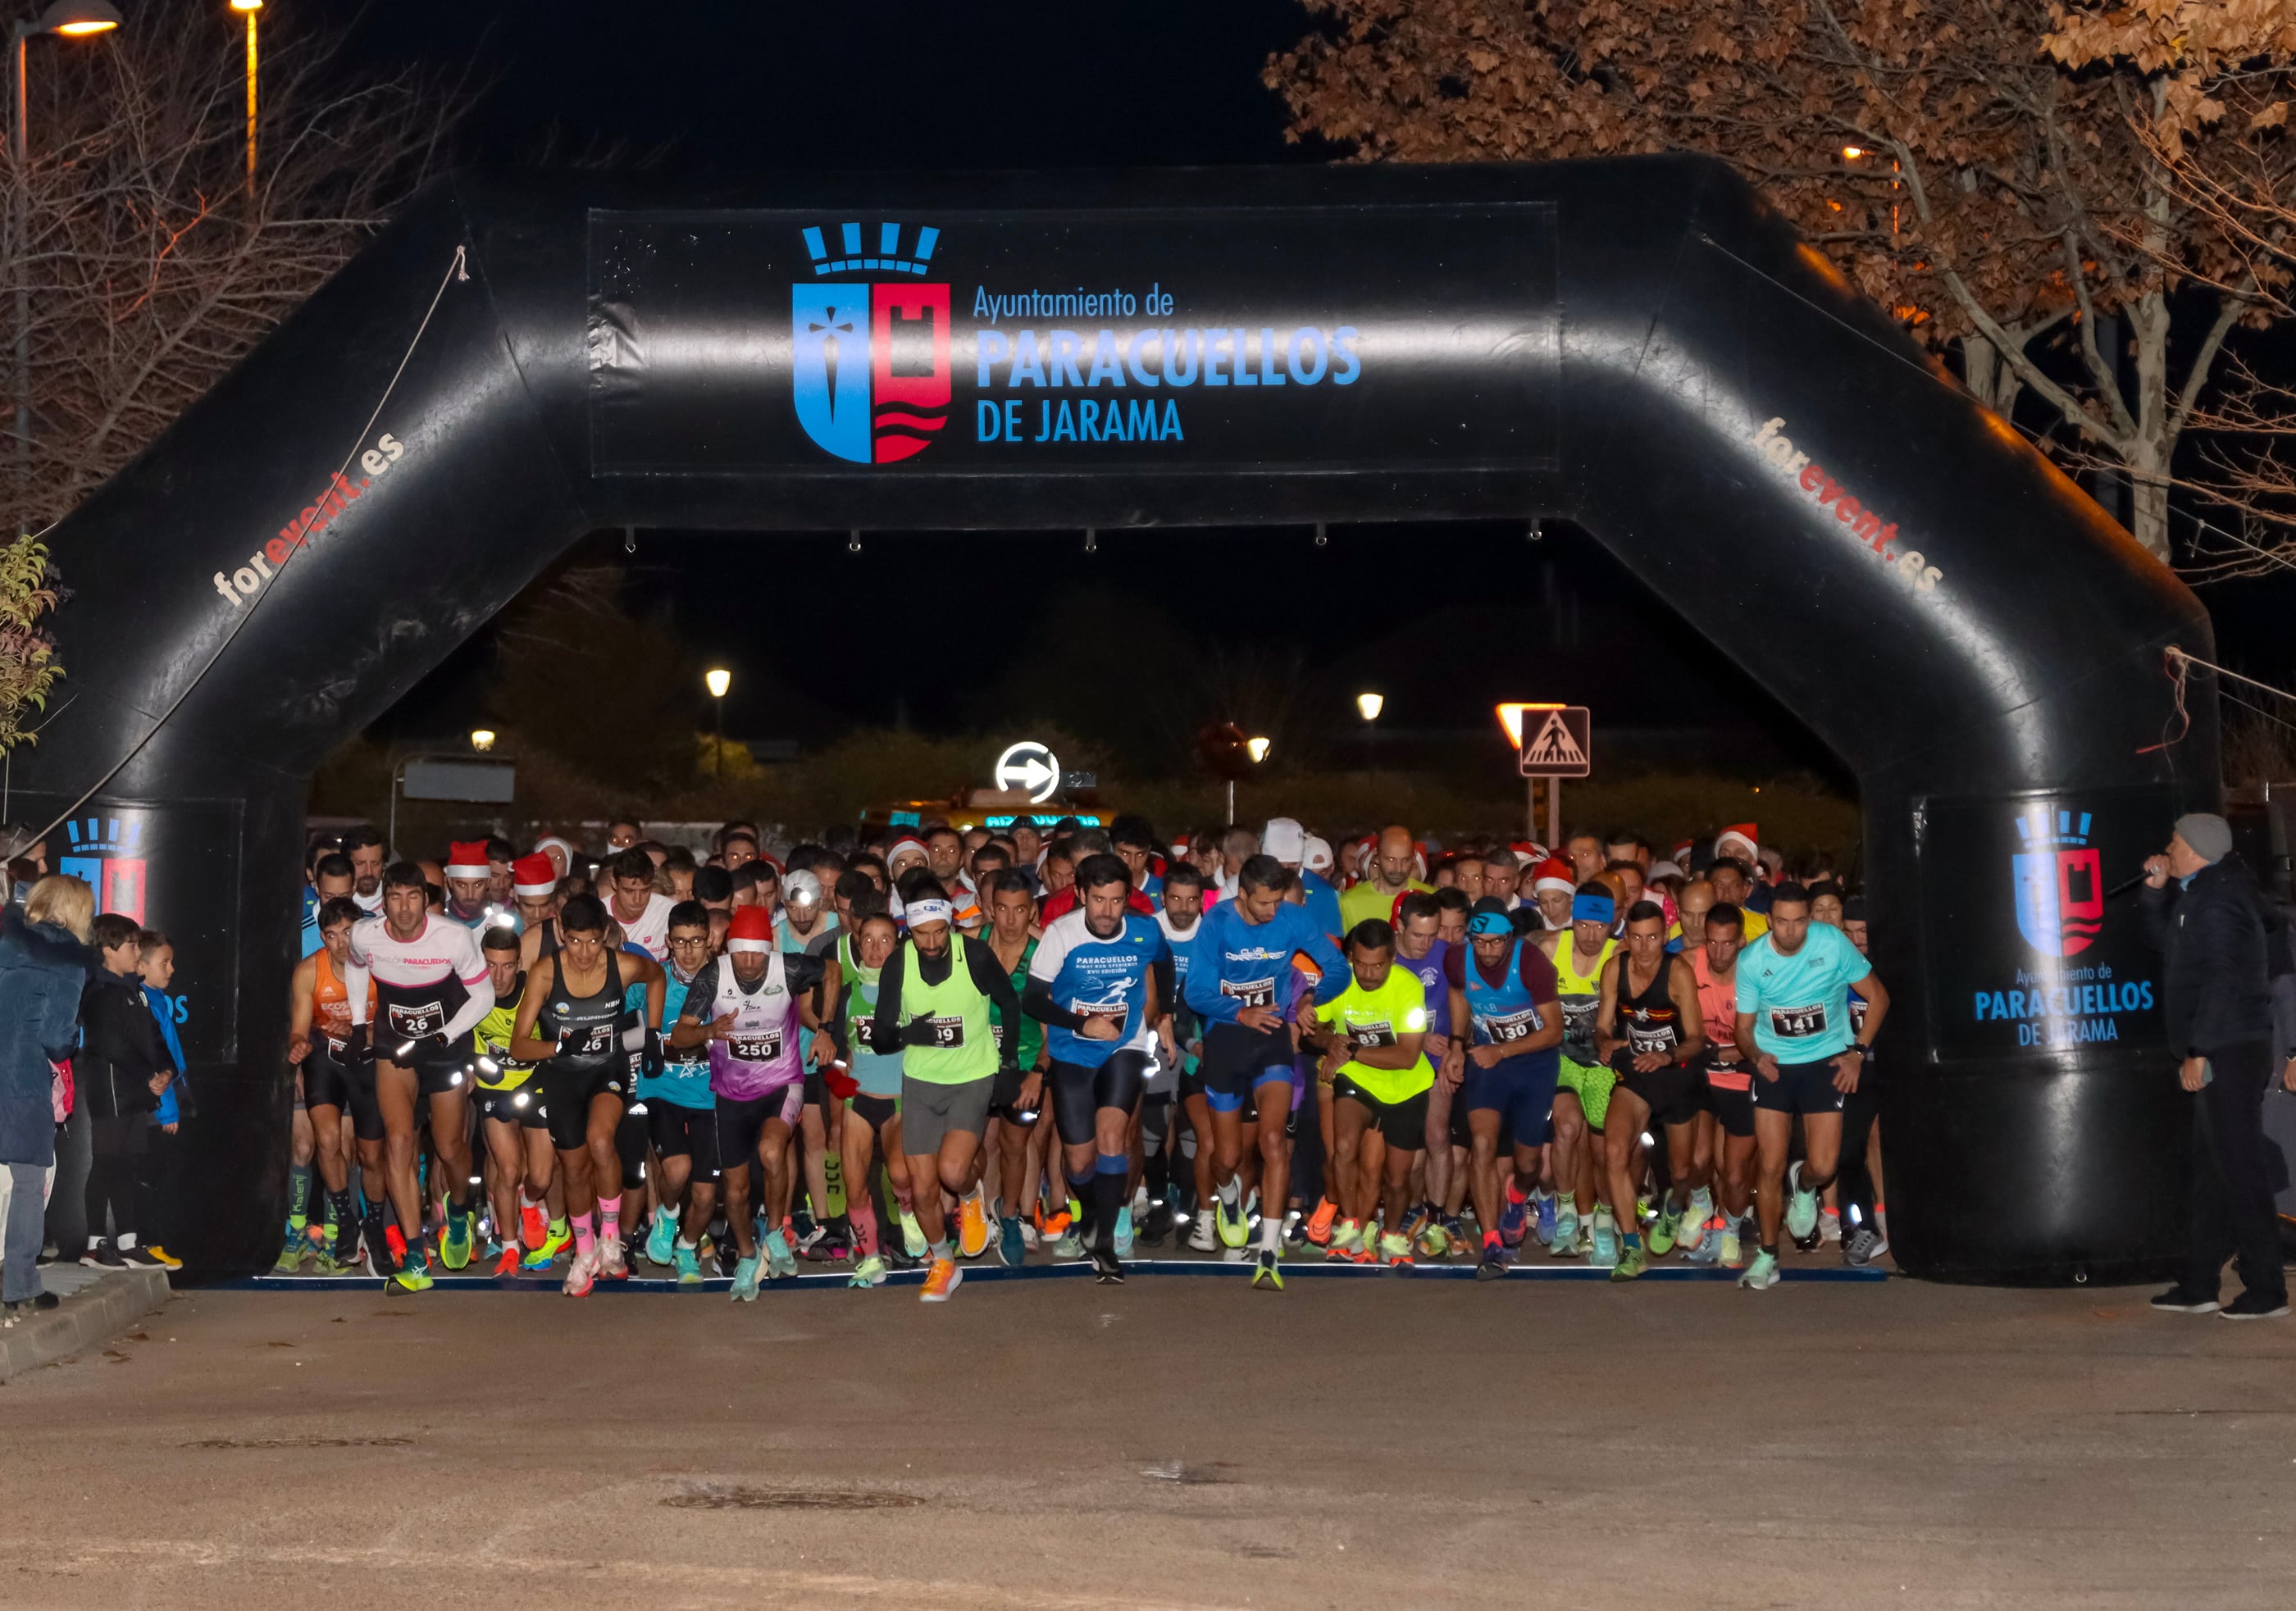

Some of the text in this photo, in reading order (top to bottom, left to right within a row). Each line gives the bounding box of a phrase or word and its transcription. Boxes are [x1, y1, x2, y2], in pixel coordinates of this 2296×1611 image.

[973, 282, 1173, 323] Ayuntamiento de
[977, 326, 1361, 388] PARACUELLOS
[977, 398, 1184, 443] DE JARAMA
[1752, 416, 1943, 592] forevent.es
[213, 433, 404, 607] forevent.es
[1076, 955, 1138, 964] PARACUELLOS
[2098, 962, 2112, 980] de
[392, 1003, 440, 1016] PARACUELLOS
[1077, 1004, 1127, 1013] PARACUELLOS
[1232, 994, 1264, 1008] 14
[1975, 980, 2155, 1022] PARACUELLOS
[405, 1017, 428, 1031] 26
[1495, 1024, 1528, 1040] 130
[1783, 1016, 1815, 1031] 141
[2017, 1017, 2119, 1047] DE JARAMA
[1358, 1033, 1381, 1045] 89
[737, 1044, 772, 1057] 250
[292, 1173, 308, 1213] Kalenji
